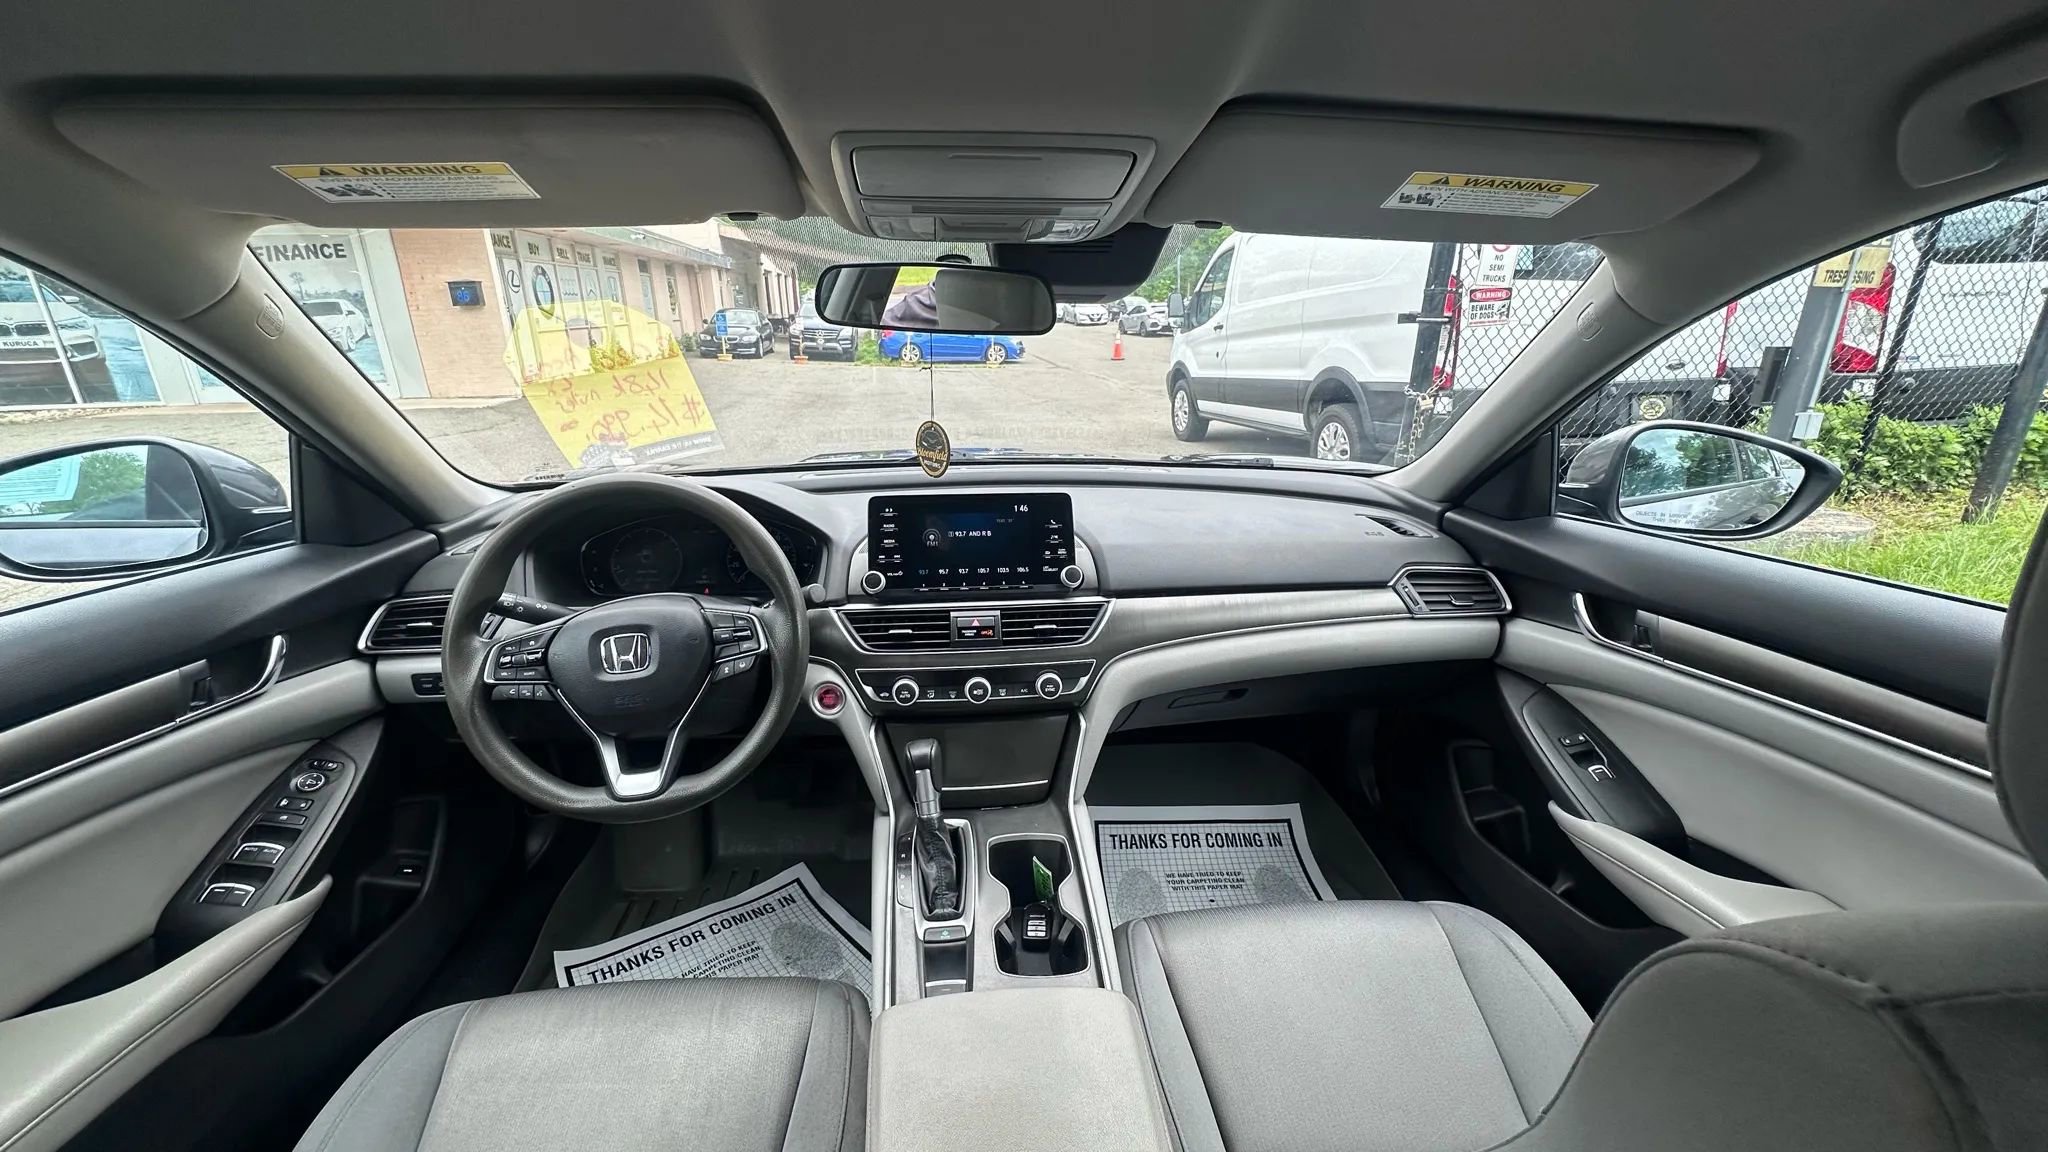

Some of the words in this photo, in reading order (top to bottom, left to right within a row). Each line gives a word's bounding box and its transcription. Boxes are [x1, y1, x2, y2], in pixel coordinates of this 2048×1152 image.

[350, 165, 482, 176] WARNING
[1463, 177, 1566, 193] WARNING
[252, 243, 347, 262] FINANCE
[527, 242, 540, 256] BUY
[556, 247, 569, 260] SELL
[1471, 304, 1495, 312] BEWARE
[1109, 833, 1168, 850] THANKS
[1171, 832, 1202, 849] FOR
[1206, 832, 1264, 849] COMING
[1268, 831, 1283, 847] IN
[587, 945, 665, 984] THANKS
[668, 930, 706, 953] FOR
[708, 903, 777, 935] COMING
[777, 893, 797, 908] IN
[703, 952, 725, 967] TRIED
[726, 947, 737, 955] TO
[737, 940, 756, 951] KEEP
[718, 960, 743, 973] PAPER
[744, 953, 760, 963] MAT
